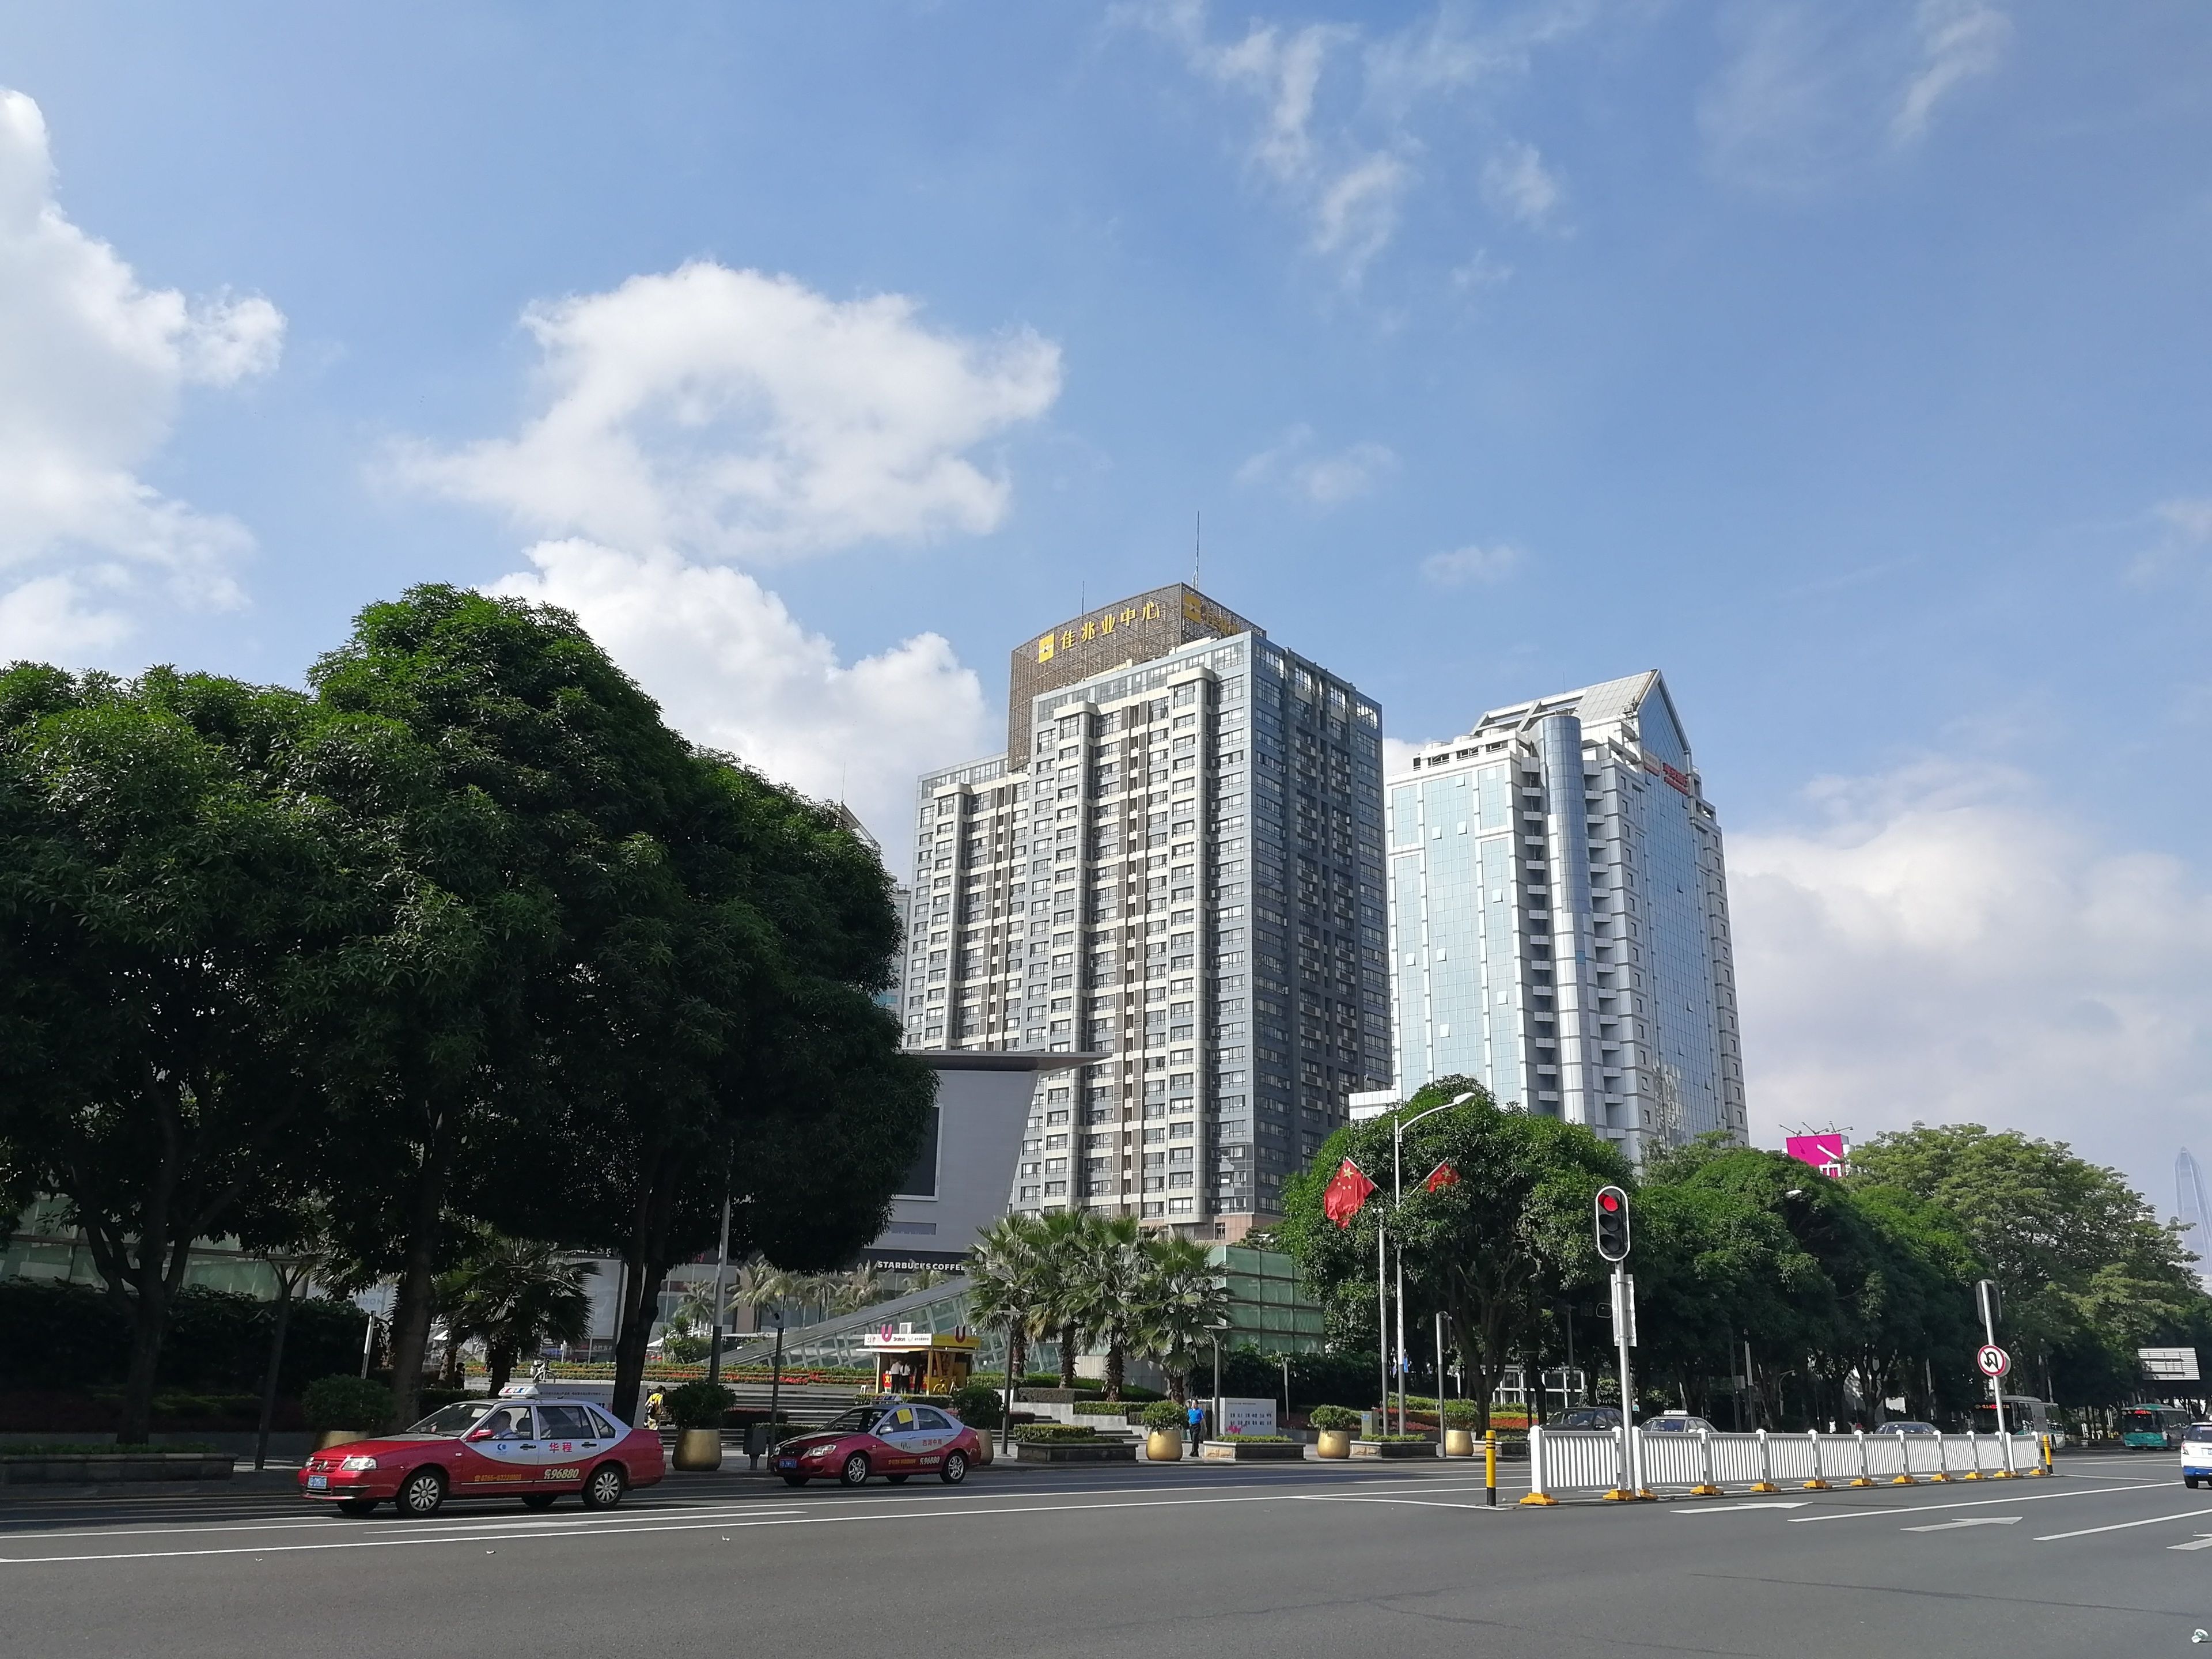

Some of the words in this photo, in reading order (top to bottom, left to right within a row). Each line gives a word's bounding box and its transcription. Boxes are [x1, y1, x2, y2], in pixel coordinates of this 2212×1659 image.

[1059, 600, 1161, 651] 佳兆业中心
[549, 1442, 573, 1453] 华程
[551, 1468, 579, 1479] 96880
